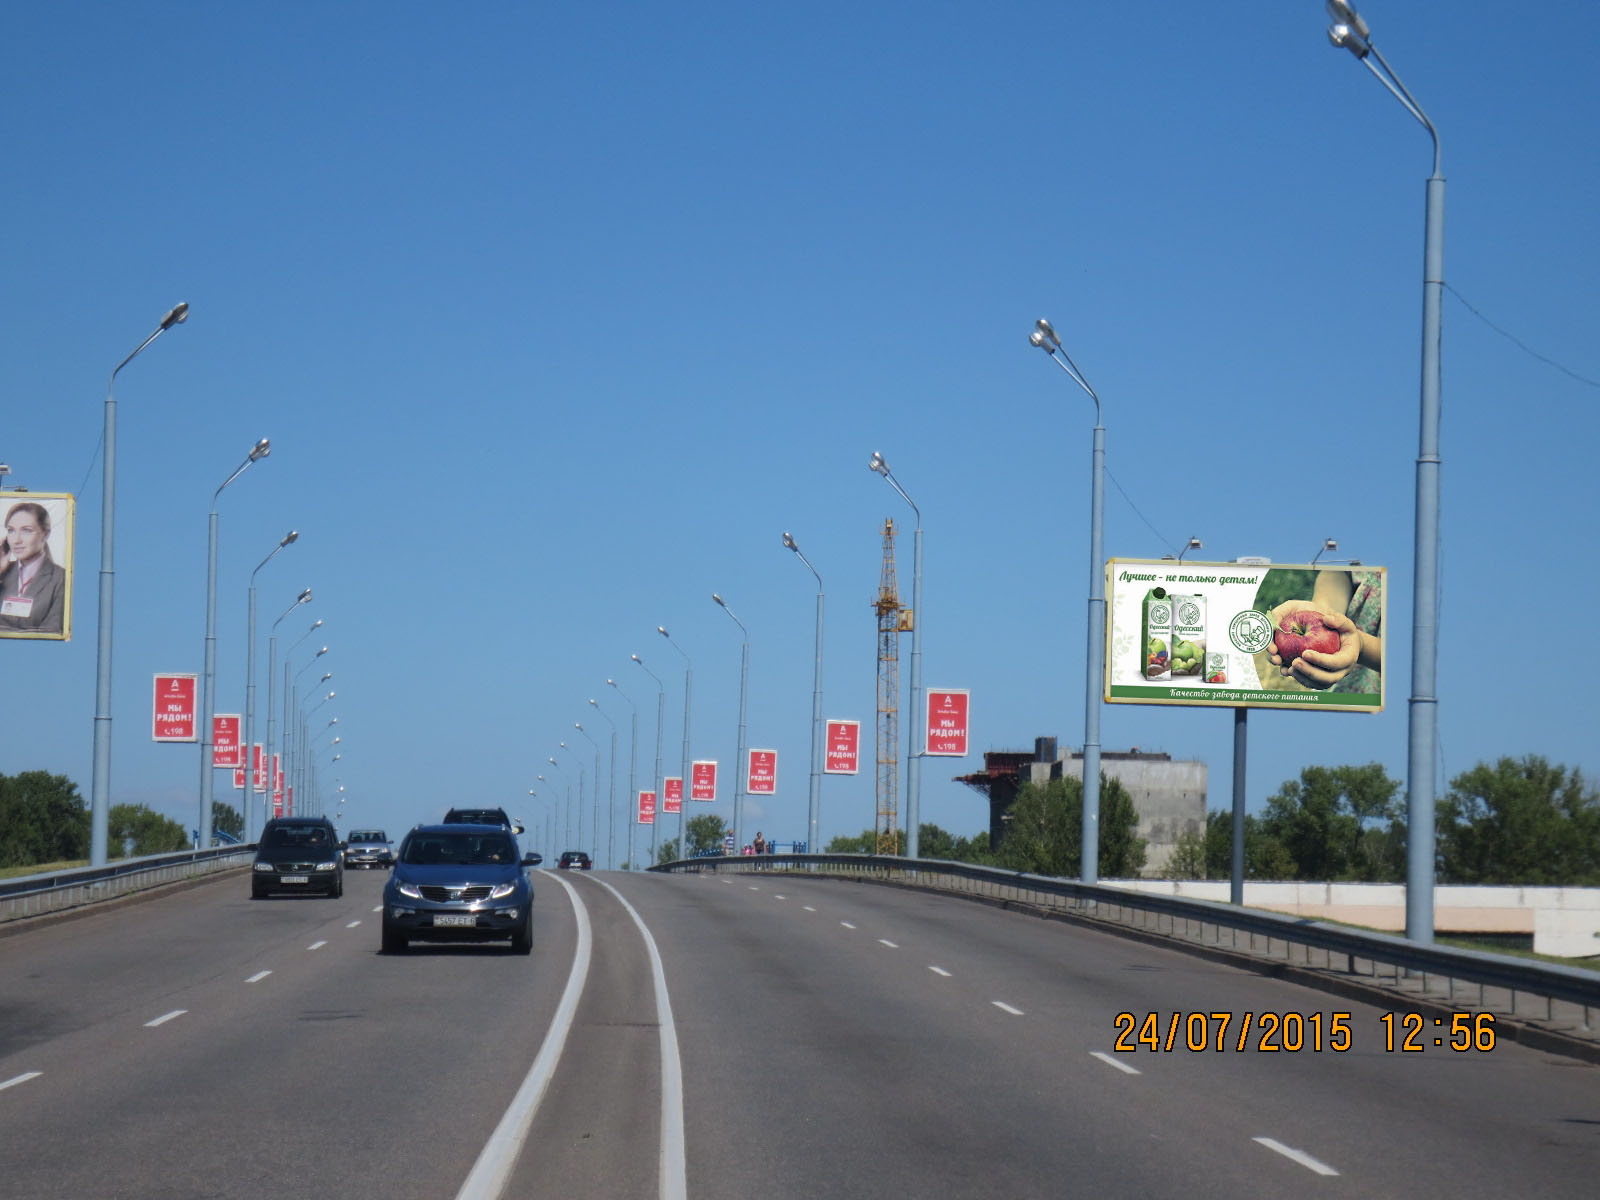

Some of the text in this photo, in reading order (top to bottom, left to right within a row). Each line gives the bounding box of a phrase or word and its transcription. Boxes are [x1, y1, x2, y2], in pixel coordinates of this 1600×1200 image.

[1119, 570, 1157, 583] Лучшее
[1165, 574, 1176, 582] не
[1178, 575, 1217, 584] только
[1219, 575, 1259, 586] детям!
[1173, 624, 1204, 633] Одесский
[1169, 688, 1320, 702] Качество завода детского питания
[167, 704, 182, 712] МЫ
[156, 713, 193, 723] РЯДОМ!
[940, 719, 956, 728] МЫ
[170, 727, 184, 735] 198
[930, 728, 966, 739] РЯДОМ!
[213, 745, 238, 753] ЯДОМ!
